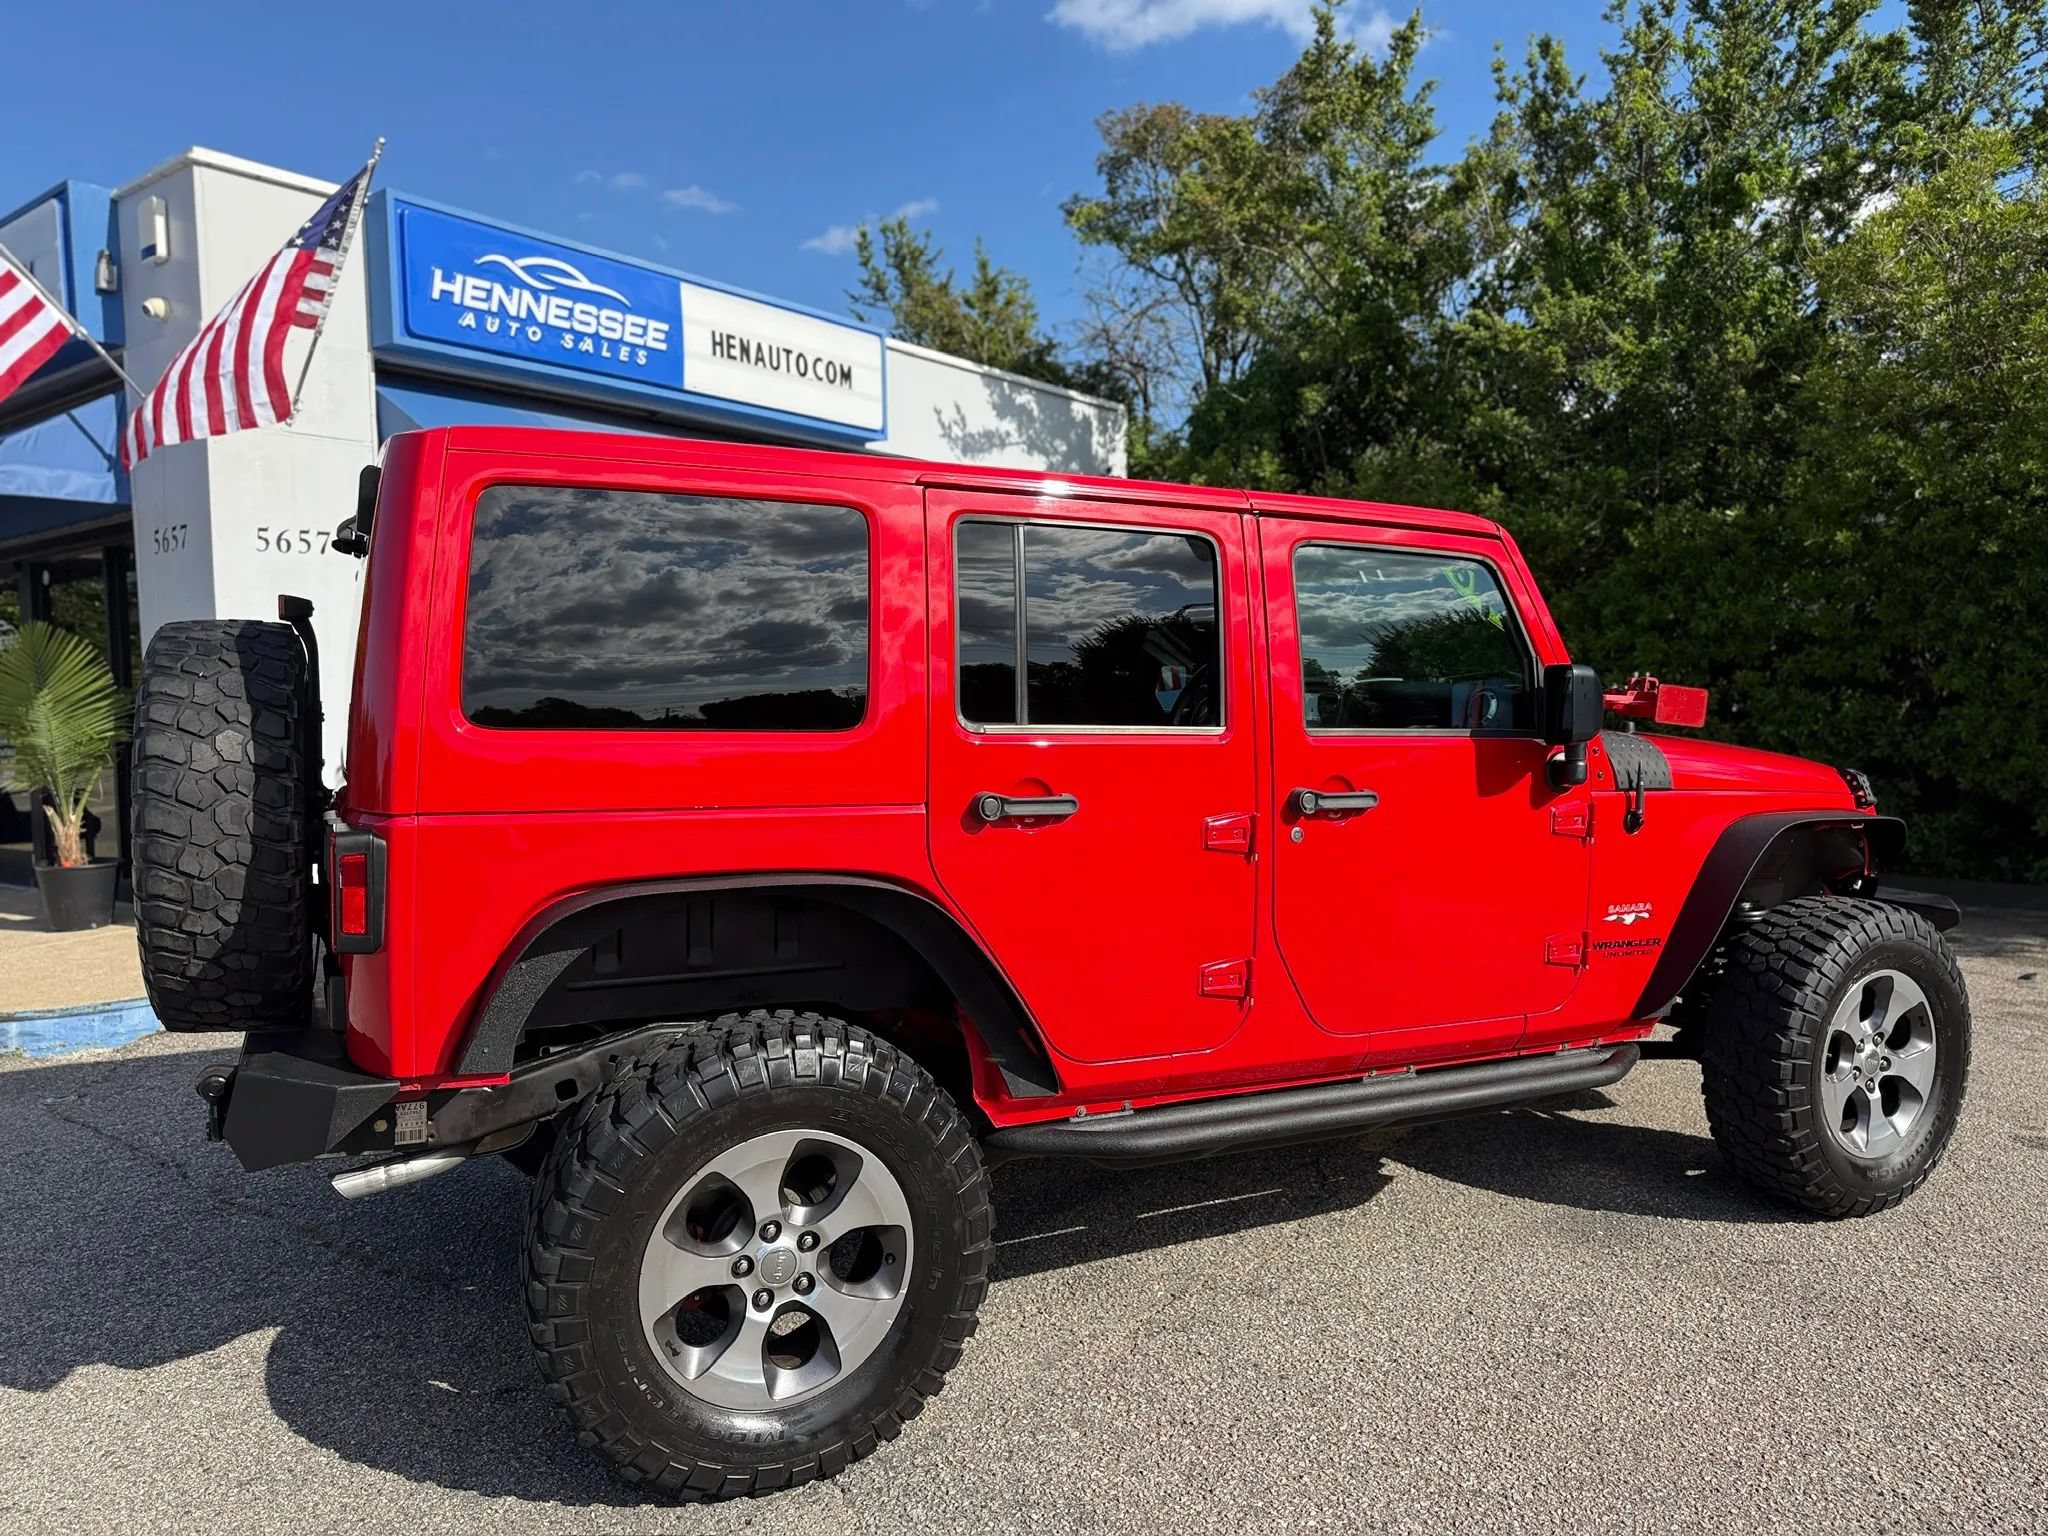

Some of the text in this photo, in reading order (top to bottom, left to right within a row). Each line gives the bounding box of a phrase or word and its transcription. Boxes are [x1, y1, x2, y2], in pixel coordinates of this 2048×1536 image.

[431, 267, 669, 351] HENNESSEE
[458, 311, 648, 365] AUTO SALES
[153, 524, 188, 555] 5657
[255, 526, 332, 555] 5657
[1607, 902, 1652, 914] SAHARA
[1592, 938, 1661, 950] WRANGLER
